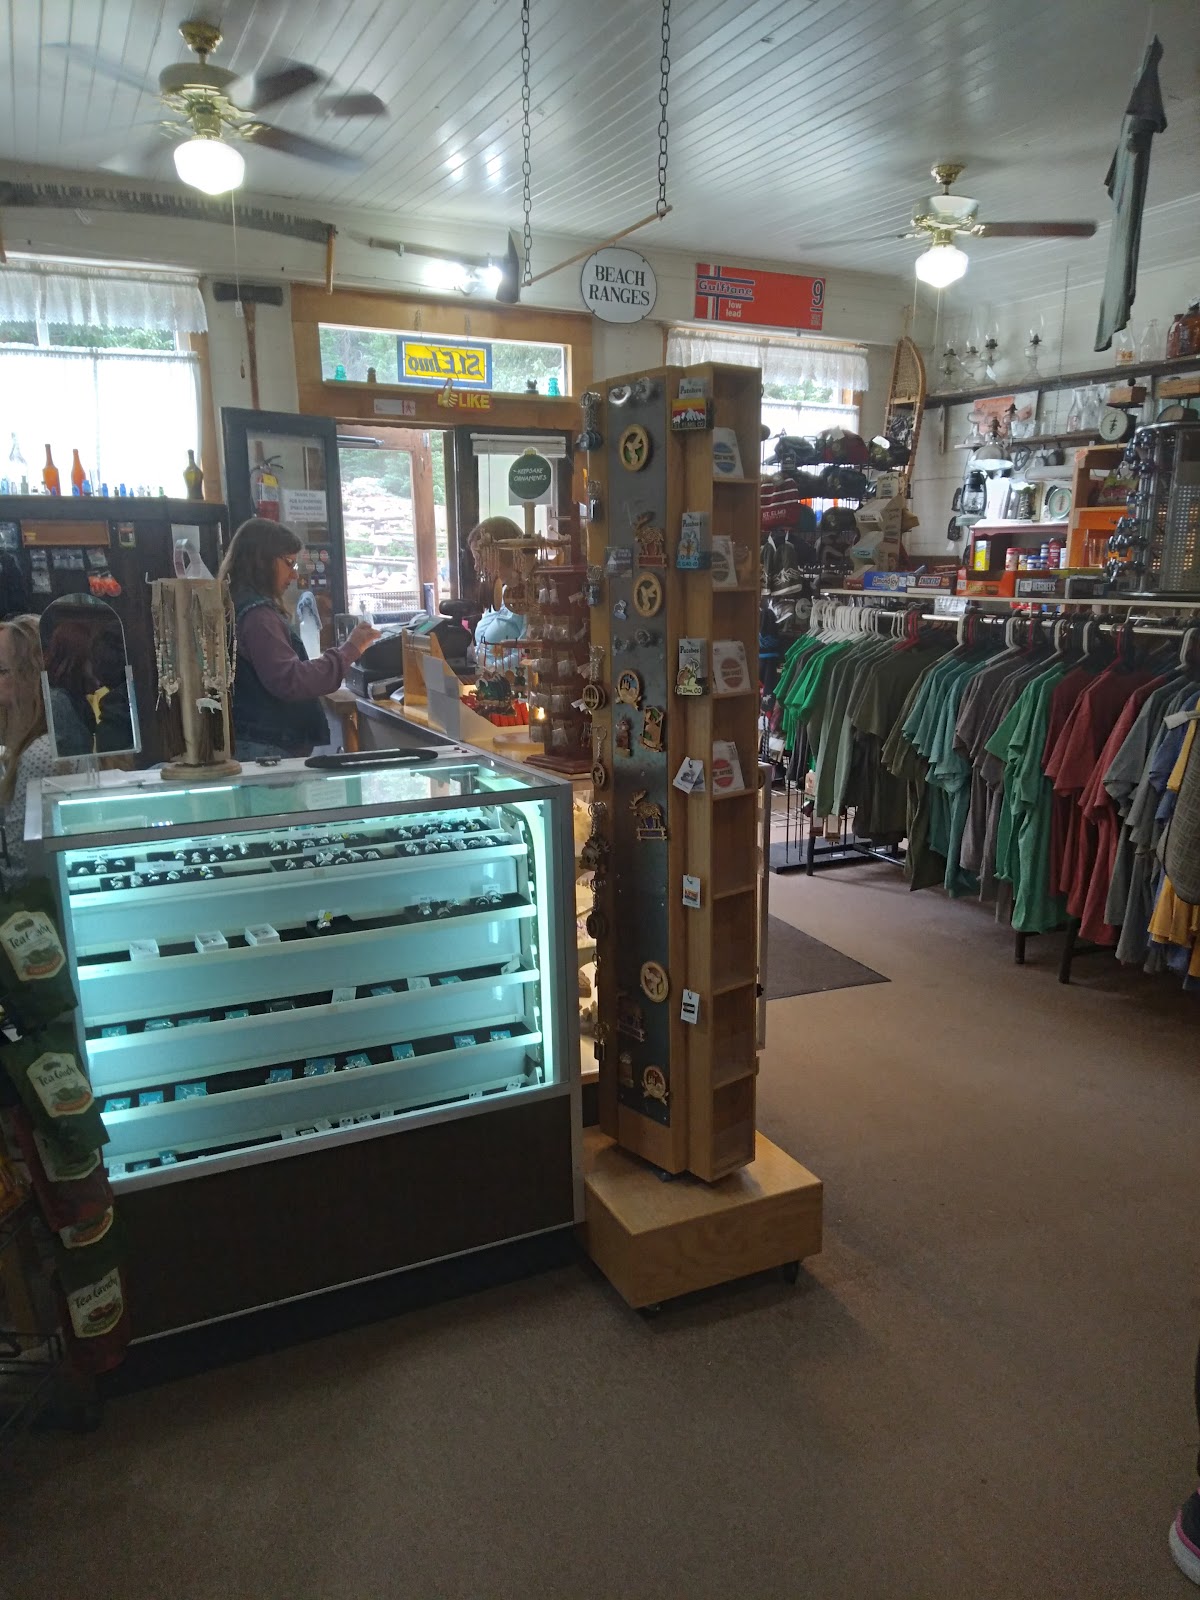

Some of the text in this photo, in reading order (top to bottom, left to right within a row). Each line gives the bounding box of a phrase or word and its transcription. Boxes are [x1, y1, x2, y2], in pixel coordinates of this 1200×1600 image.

[595, 265, 645, 286] BEACH
[589, 284, 650, 306] RANGES
[698, 280, 753, 296] Gulftane
[812, 279, 824, 307] 9
[728, 300, 742, 309] low
[725, 308, 742, 318] lead
[458, 393, 490, 409] LIKE
[513, 474, 547, 482] ORNAMENTS
[919, 576, 941, 585] SNICKERS
[1032, 580, 1056, 592] HERSHEY'S
[8, 933, 26, 949] Tea
[36, 1065, 77, 1086] Tea Candy
[75, 1276, 118, 1309] Tea Candy
